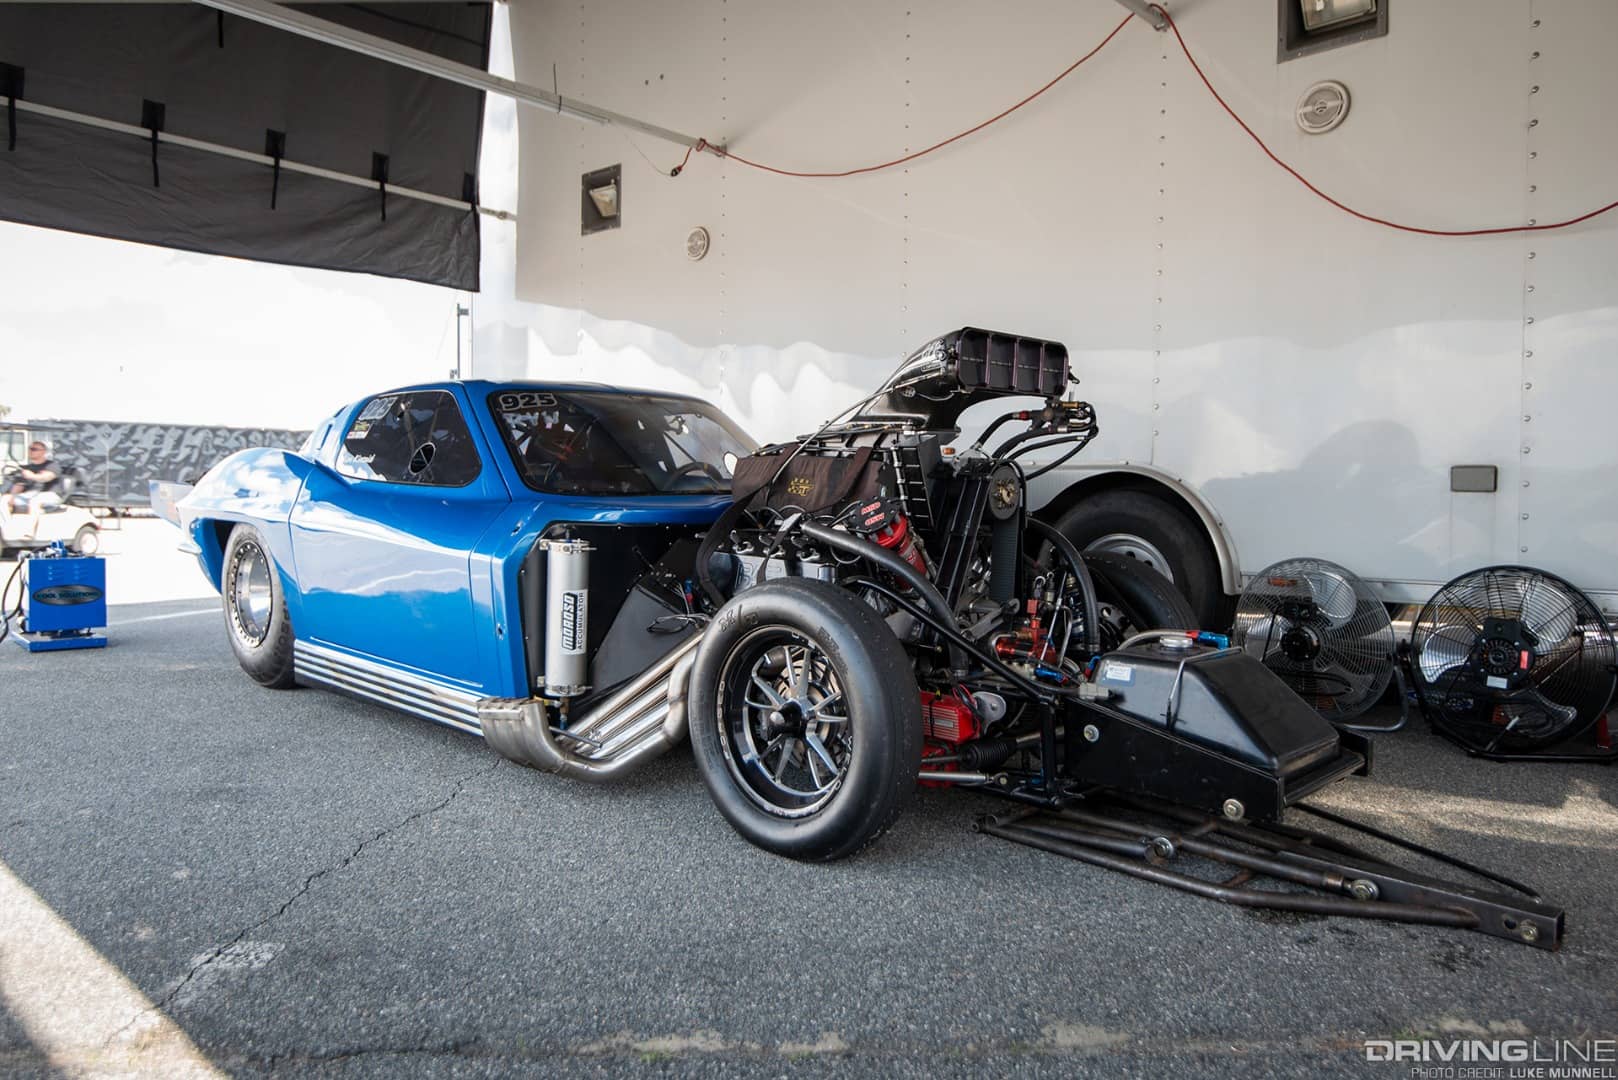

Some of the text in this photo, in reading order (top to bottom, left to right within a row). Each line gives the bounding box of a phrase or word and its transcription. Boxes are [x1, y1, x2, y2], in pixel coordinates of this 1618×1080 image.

[500, 393, 557, 411] 925
[562, 592, 578, 651] MOROSO
[577, 592, 585, 650] ACCUMULATOR
